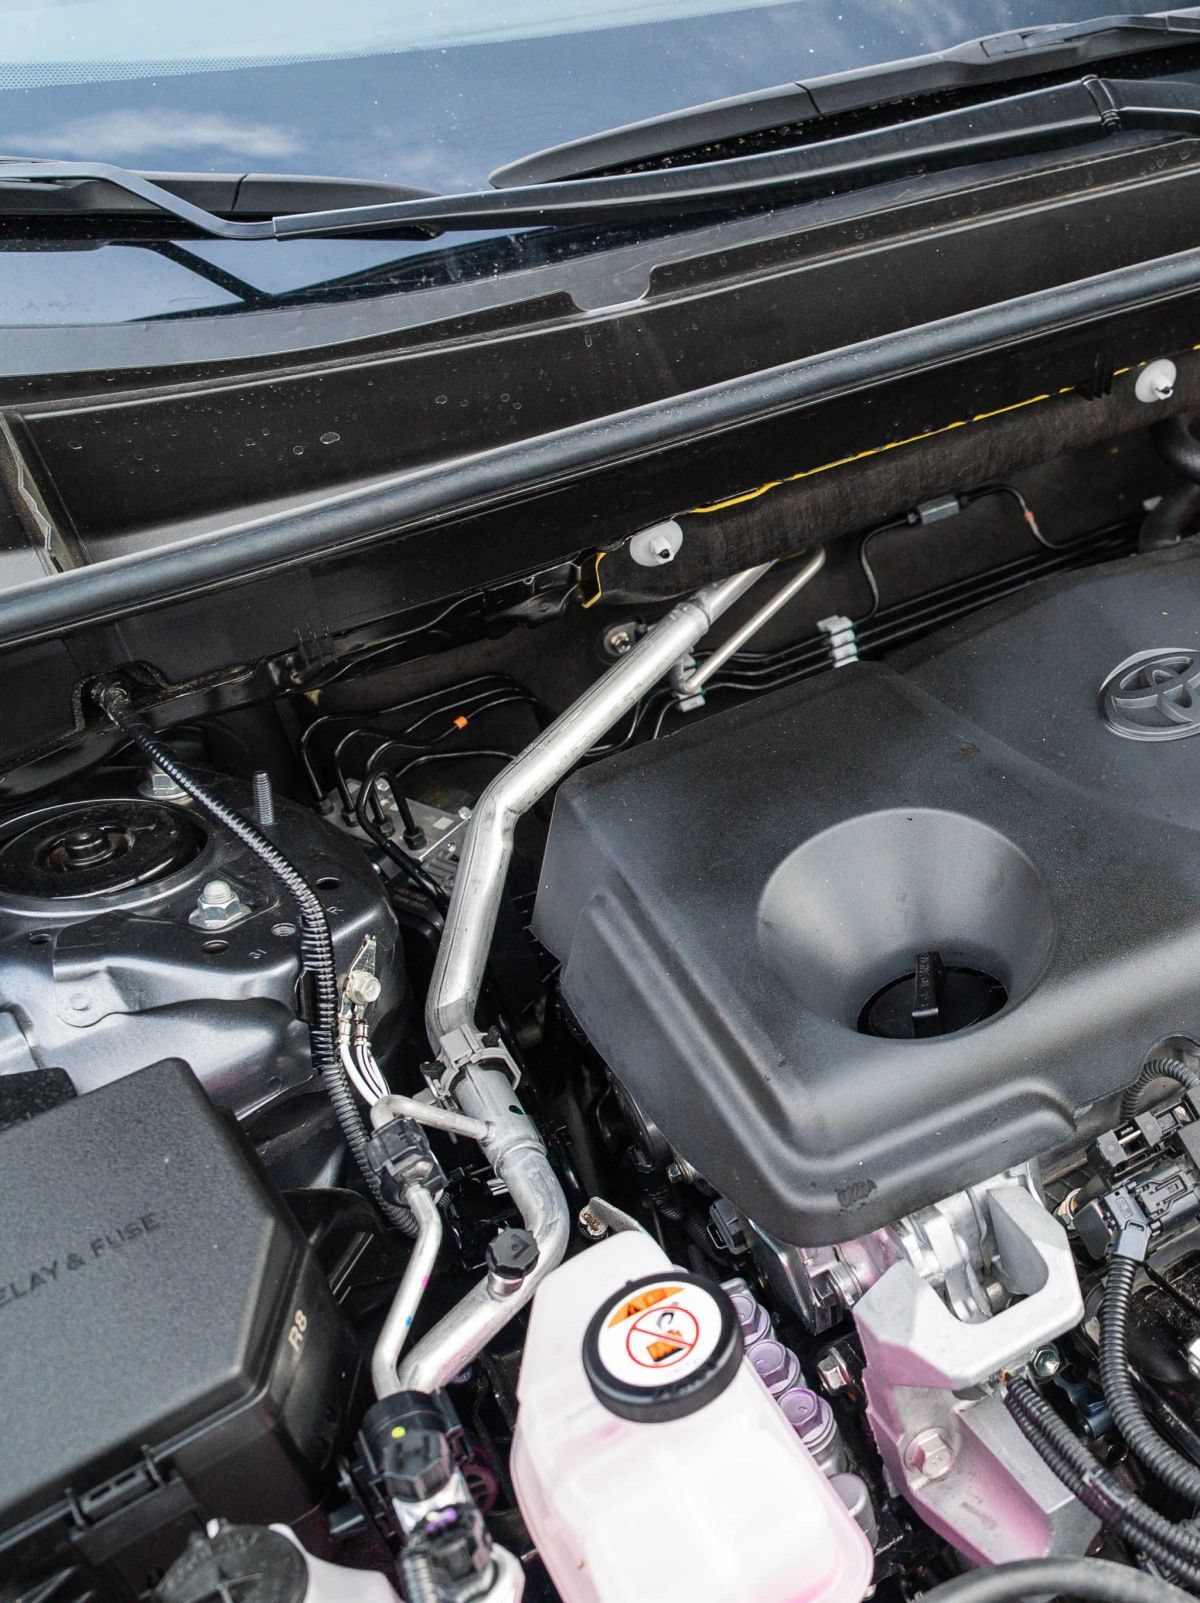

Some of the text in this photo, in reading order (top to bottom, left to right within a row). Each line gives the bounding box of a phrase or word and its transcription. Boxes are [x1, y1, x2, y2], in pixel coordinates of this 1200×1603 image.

[66, 1252, 86, 1270] &
[90, 1212, 161, 1258] FUSE
[288, 1309, 307, 1351] R8
